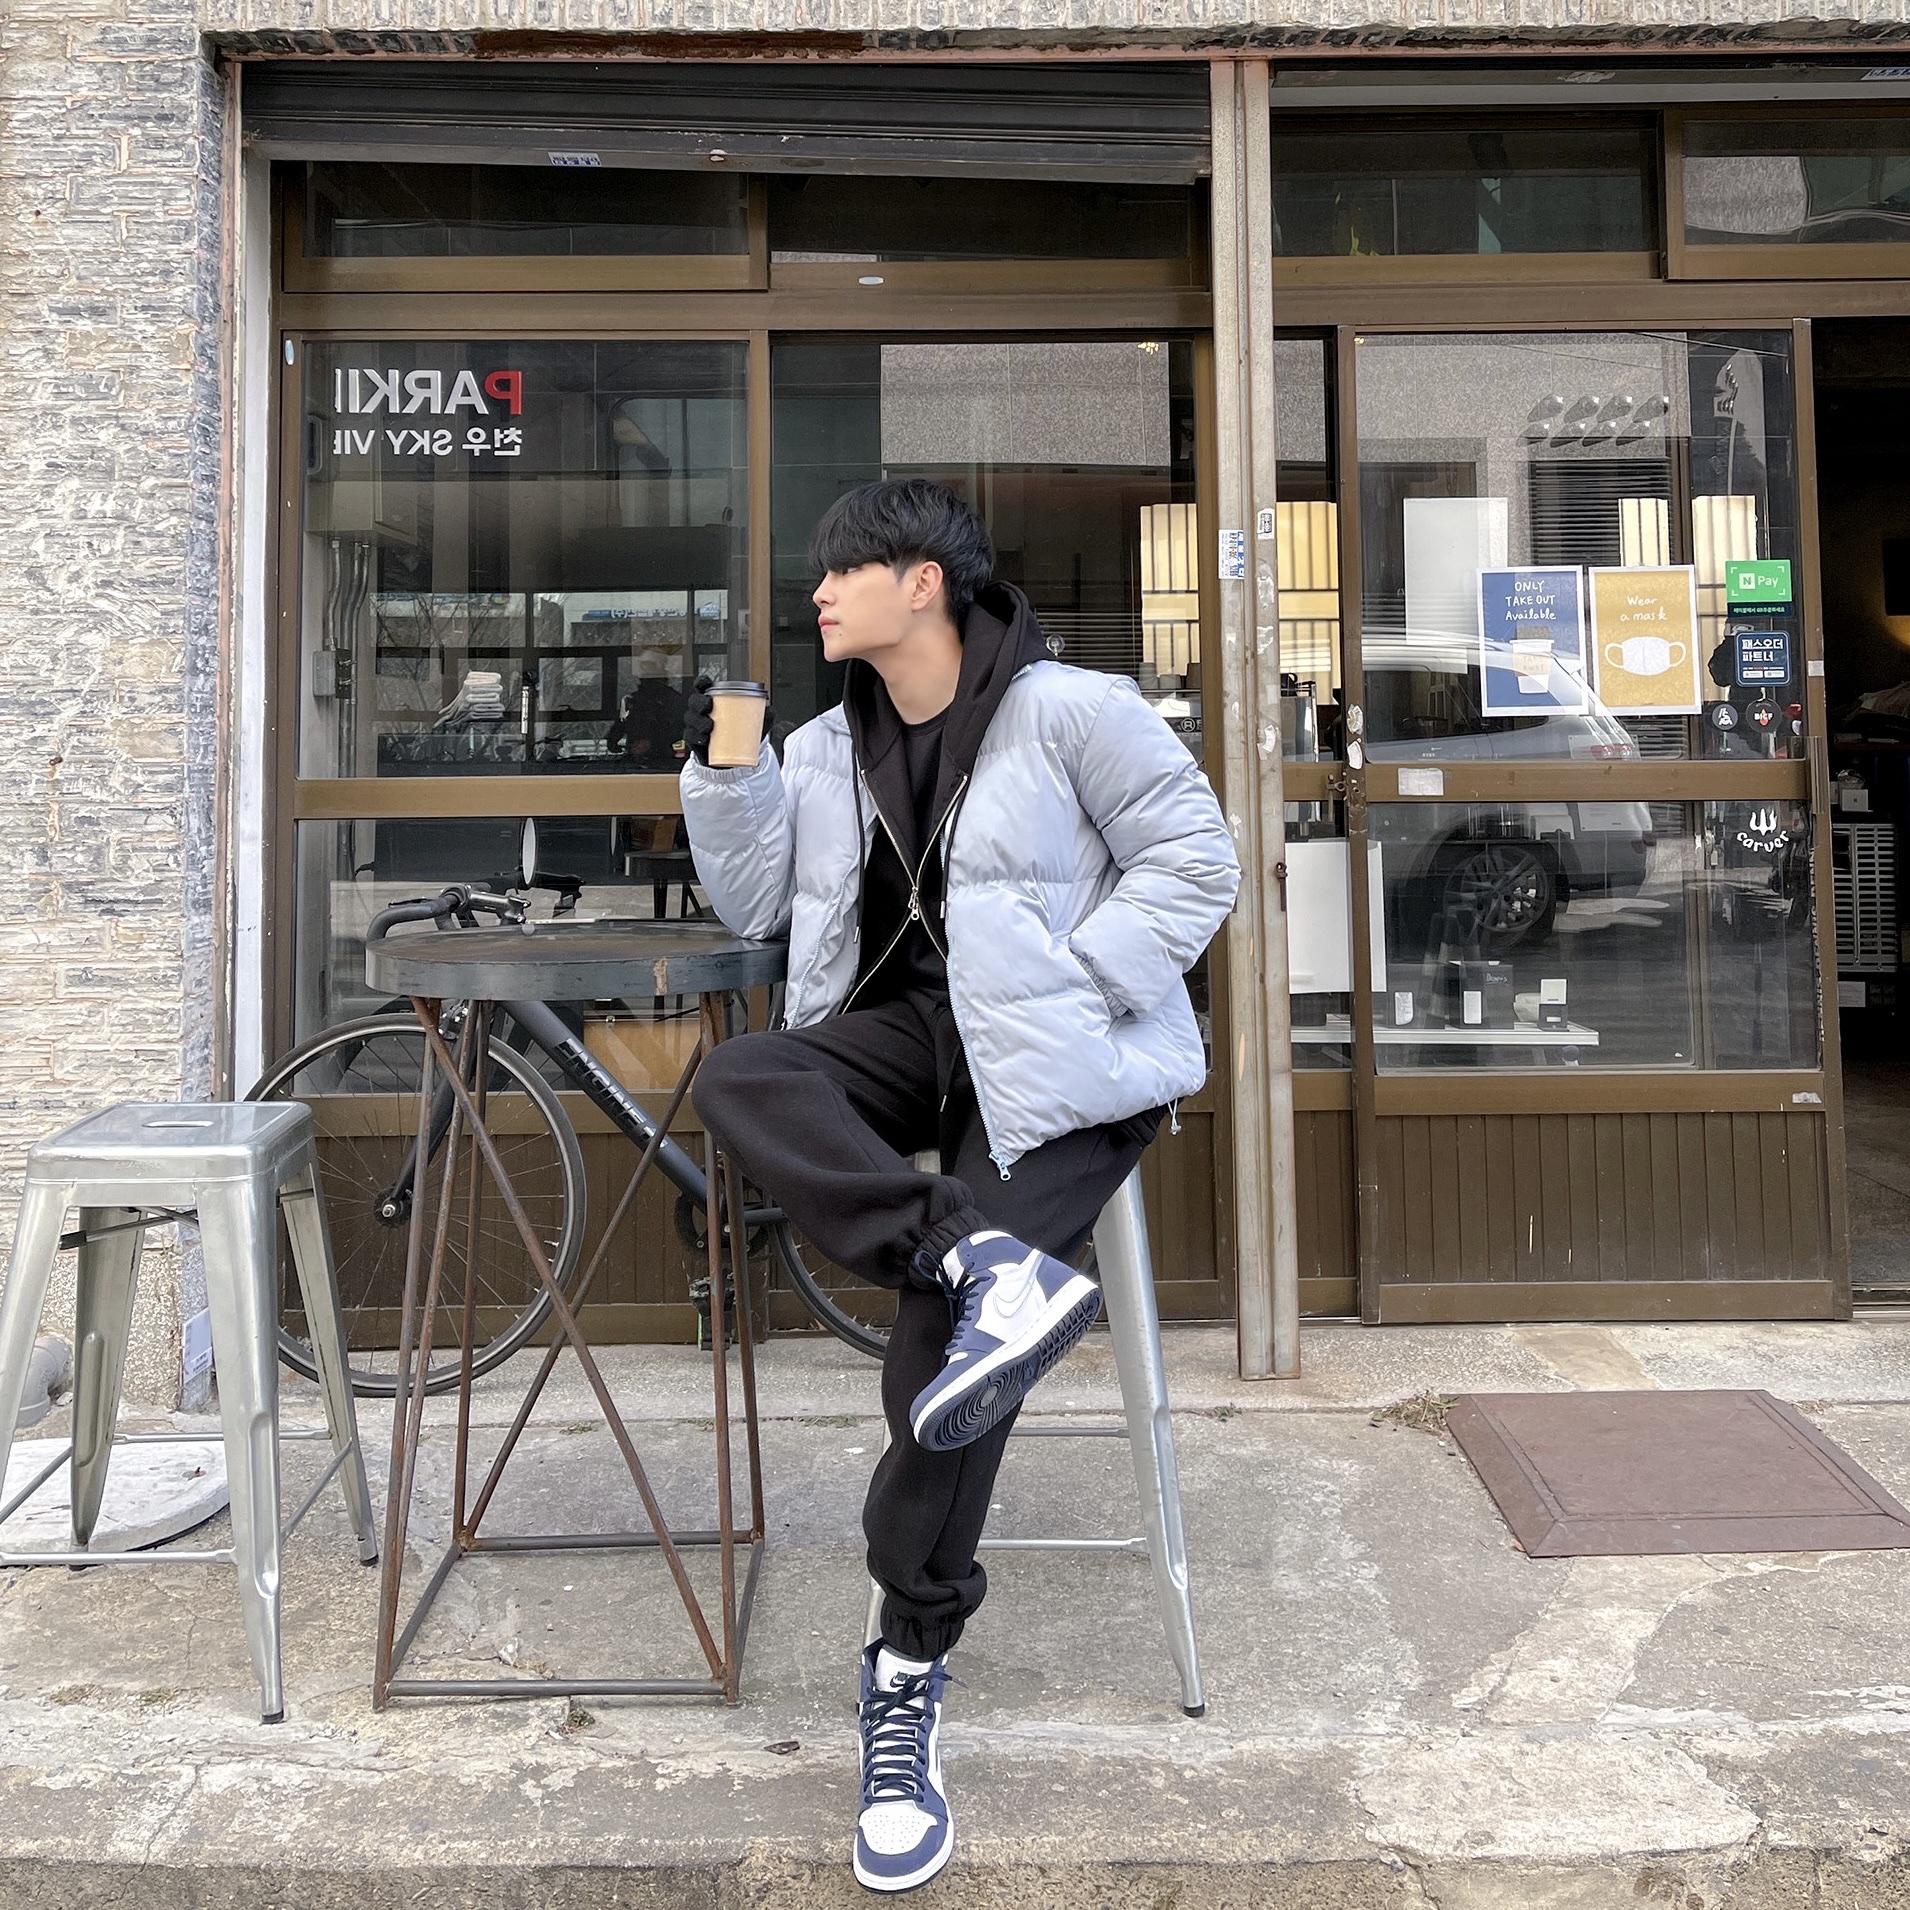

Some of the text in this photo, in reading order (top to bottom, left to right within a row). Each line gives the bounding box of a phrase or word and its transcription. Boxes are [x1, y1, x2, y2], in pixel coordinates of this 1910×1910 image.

[1514, 579, 1545, 593] ONLY
[1757, 576, 1779, 588] Pay
[1505, 594, 1556, 607] TAKE OUT
[1626, 595, 1658, 606] Wear
[1505, 608, 1557, 621] Available
[1620, 606, 1668, 622] a mask
[1741, 638, 1784, 650] 패스오더
[1742, 650, 1774, 662] 파트너
[1736, 830, 1790, 853] carver
